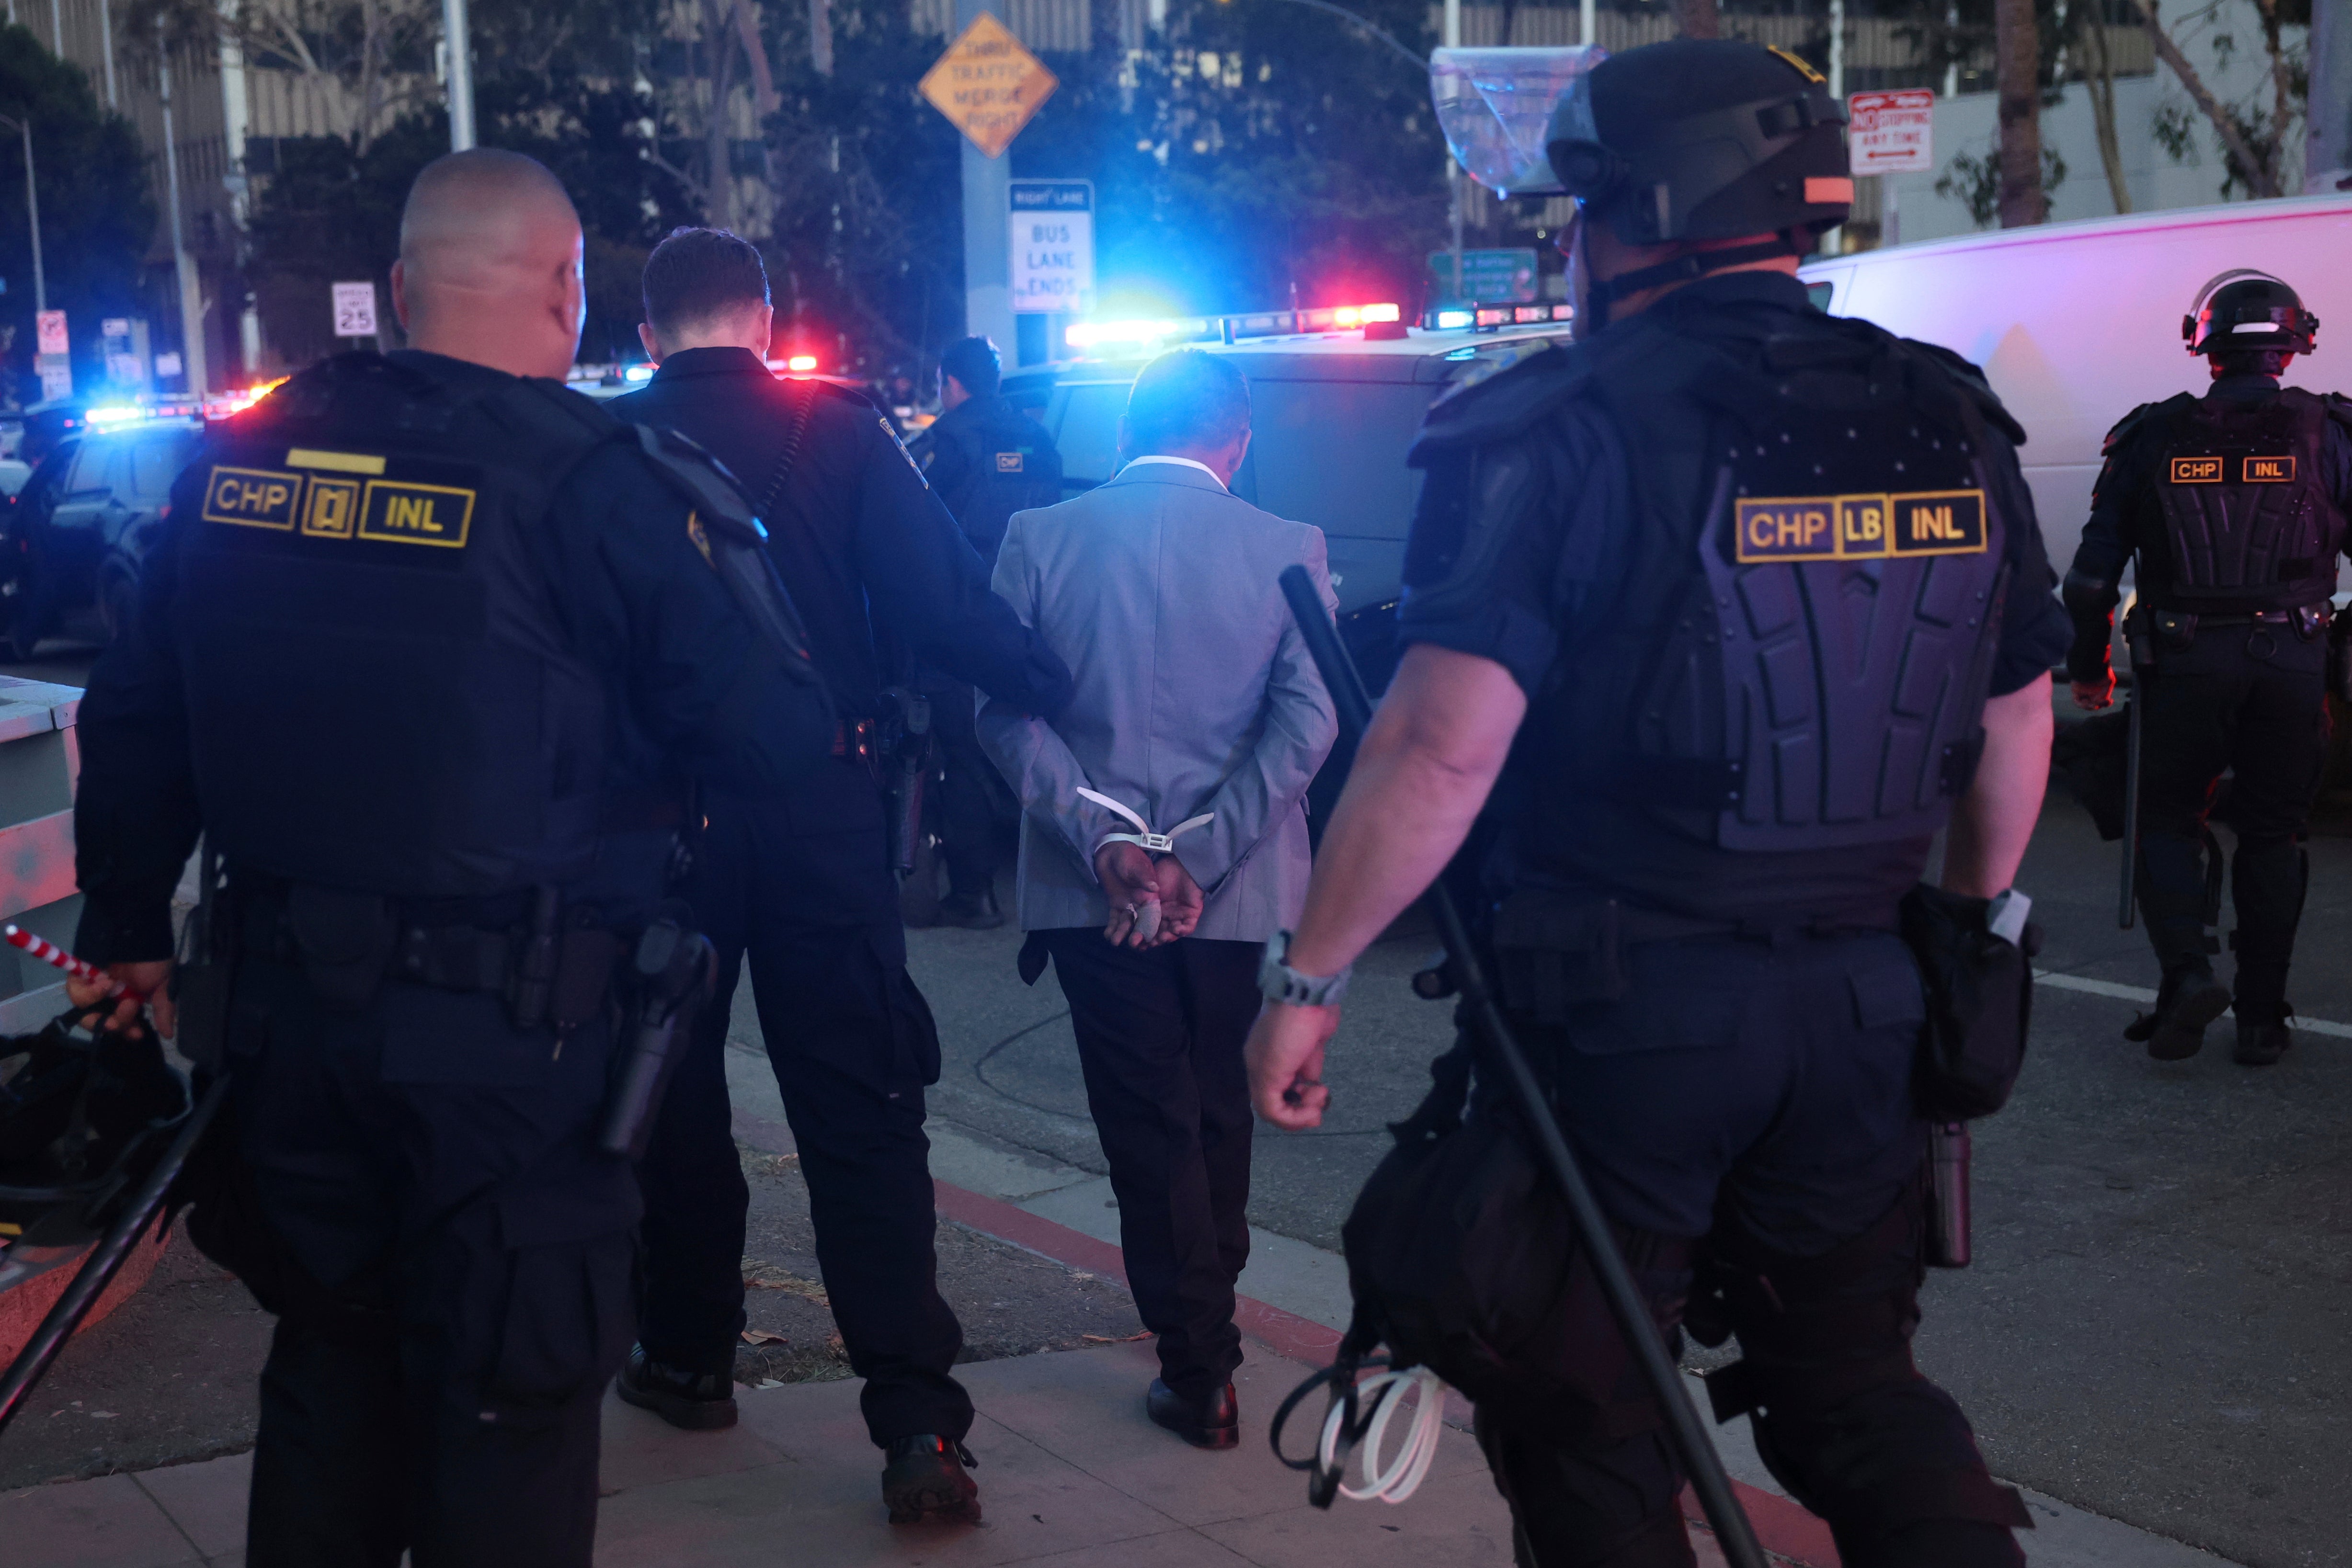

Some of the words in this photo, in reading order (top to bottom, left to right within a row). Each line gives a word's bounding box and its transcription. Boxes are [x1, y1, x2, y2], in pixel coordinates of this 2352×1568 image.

[951, 64, 1025, 80] TRAFFIC
[953, 87, 1022, 106] MERGE
[967, 111, 1017, 129] RIGHT
[1853, 110, 1878, 130] NO
[1862, 134, 1886, 145] ANY
[1893, 133, 1920, 144] TIME
[1055, 193, 1083, 205] LANE
[1032, 224, 1070, 243] BUS
[1027, 251, 1074, 269] LANE
[1028, 277, 1076, 295] ENDS
[341, 309, 371, 330] 25
[2178, 463, 2216, 477] CHP
[2255, 462, 2283, 476] INL
[216, 479, 287, 513] CHP
[385, 495, 443, 532] INL
[1748, 511, 1827, 547] CHP
[1845, 507, 1883, 541] LB
[1911, 505, 1964, 540] INL
